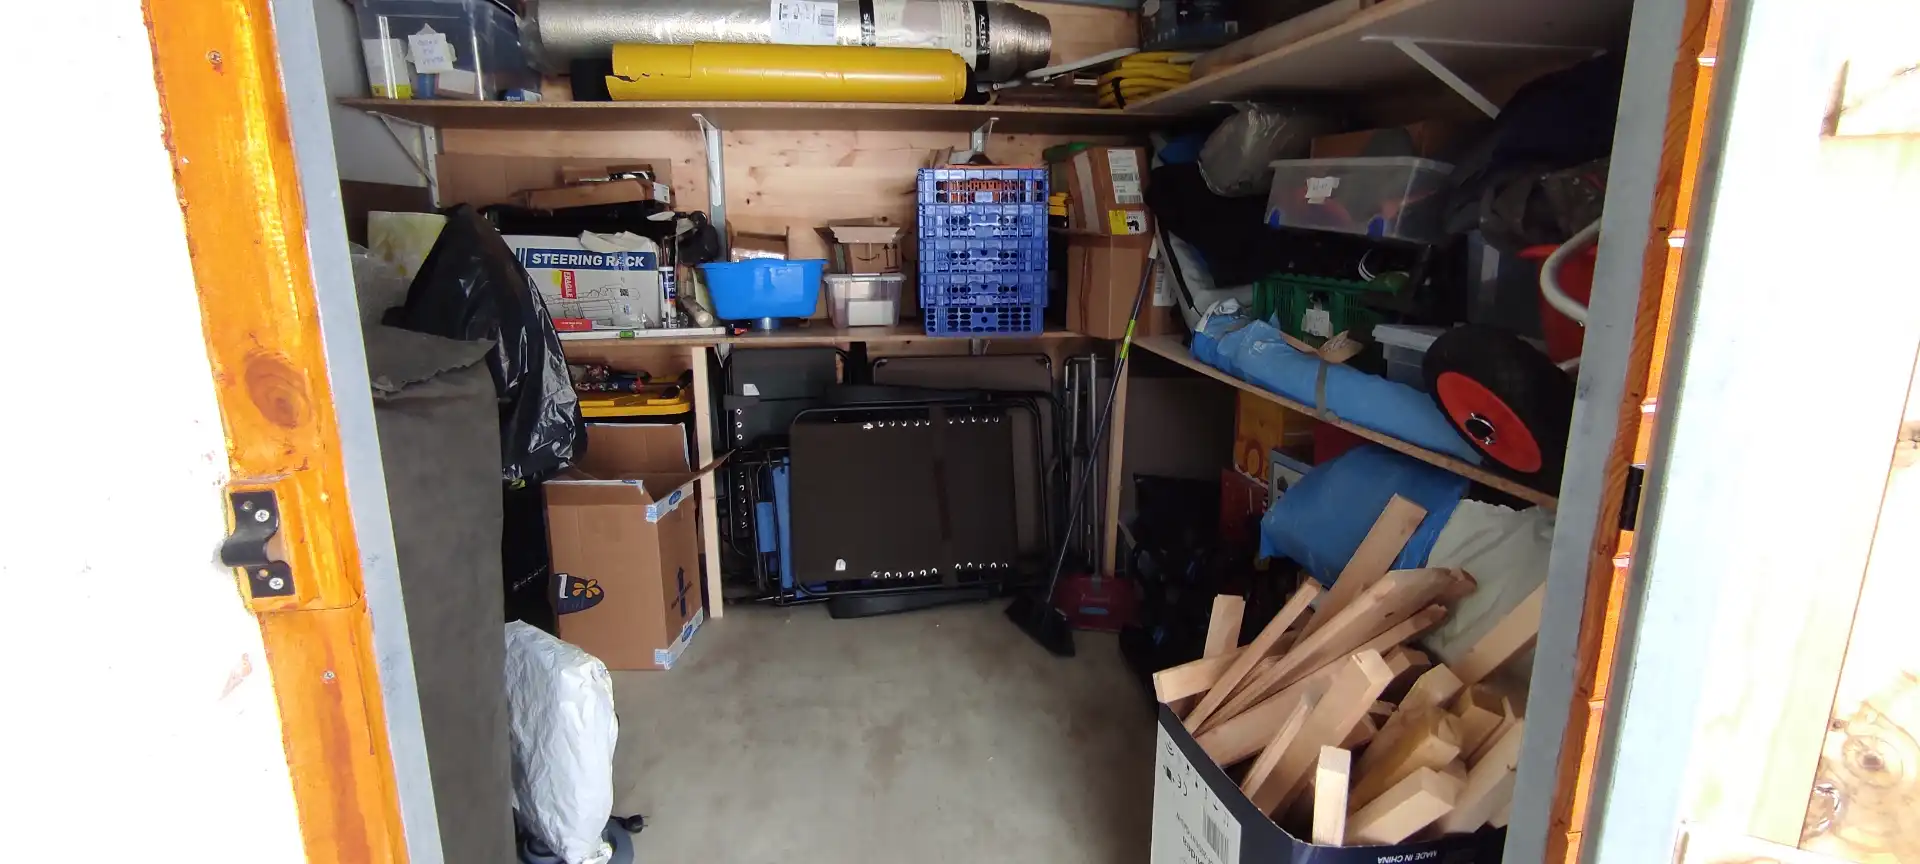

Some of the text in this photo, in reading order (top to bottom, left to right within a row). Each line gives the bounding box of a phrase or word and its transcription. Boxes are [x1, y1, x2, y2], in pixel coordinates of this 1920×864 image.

[979, 14, 987, 48] ACTIS
[532, 253, 645, 267] STEERING RACK
[563, 271, 573, 298] FRAGILE
[1377, 850, 1437, 864] MADE IN CHINA
